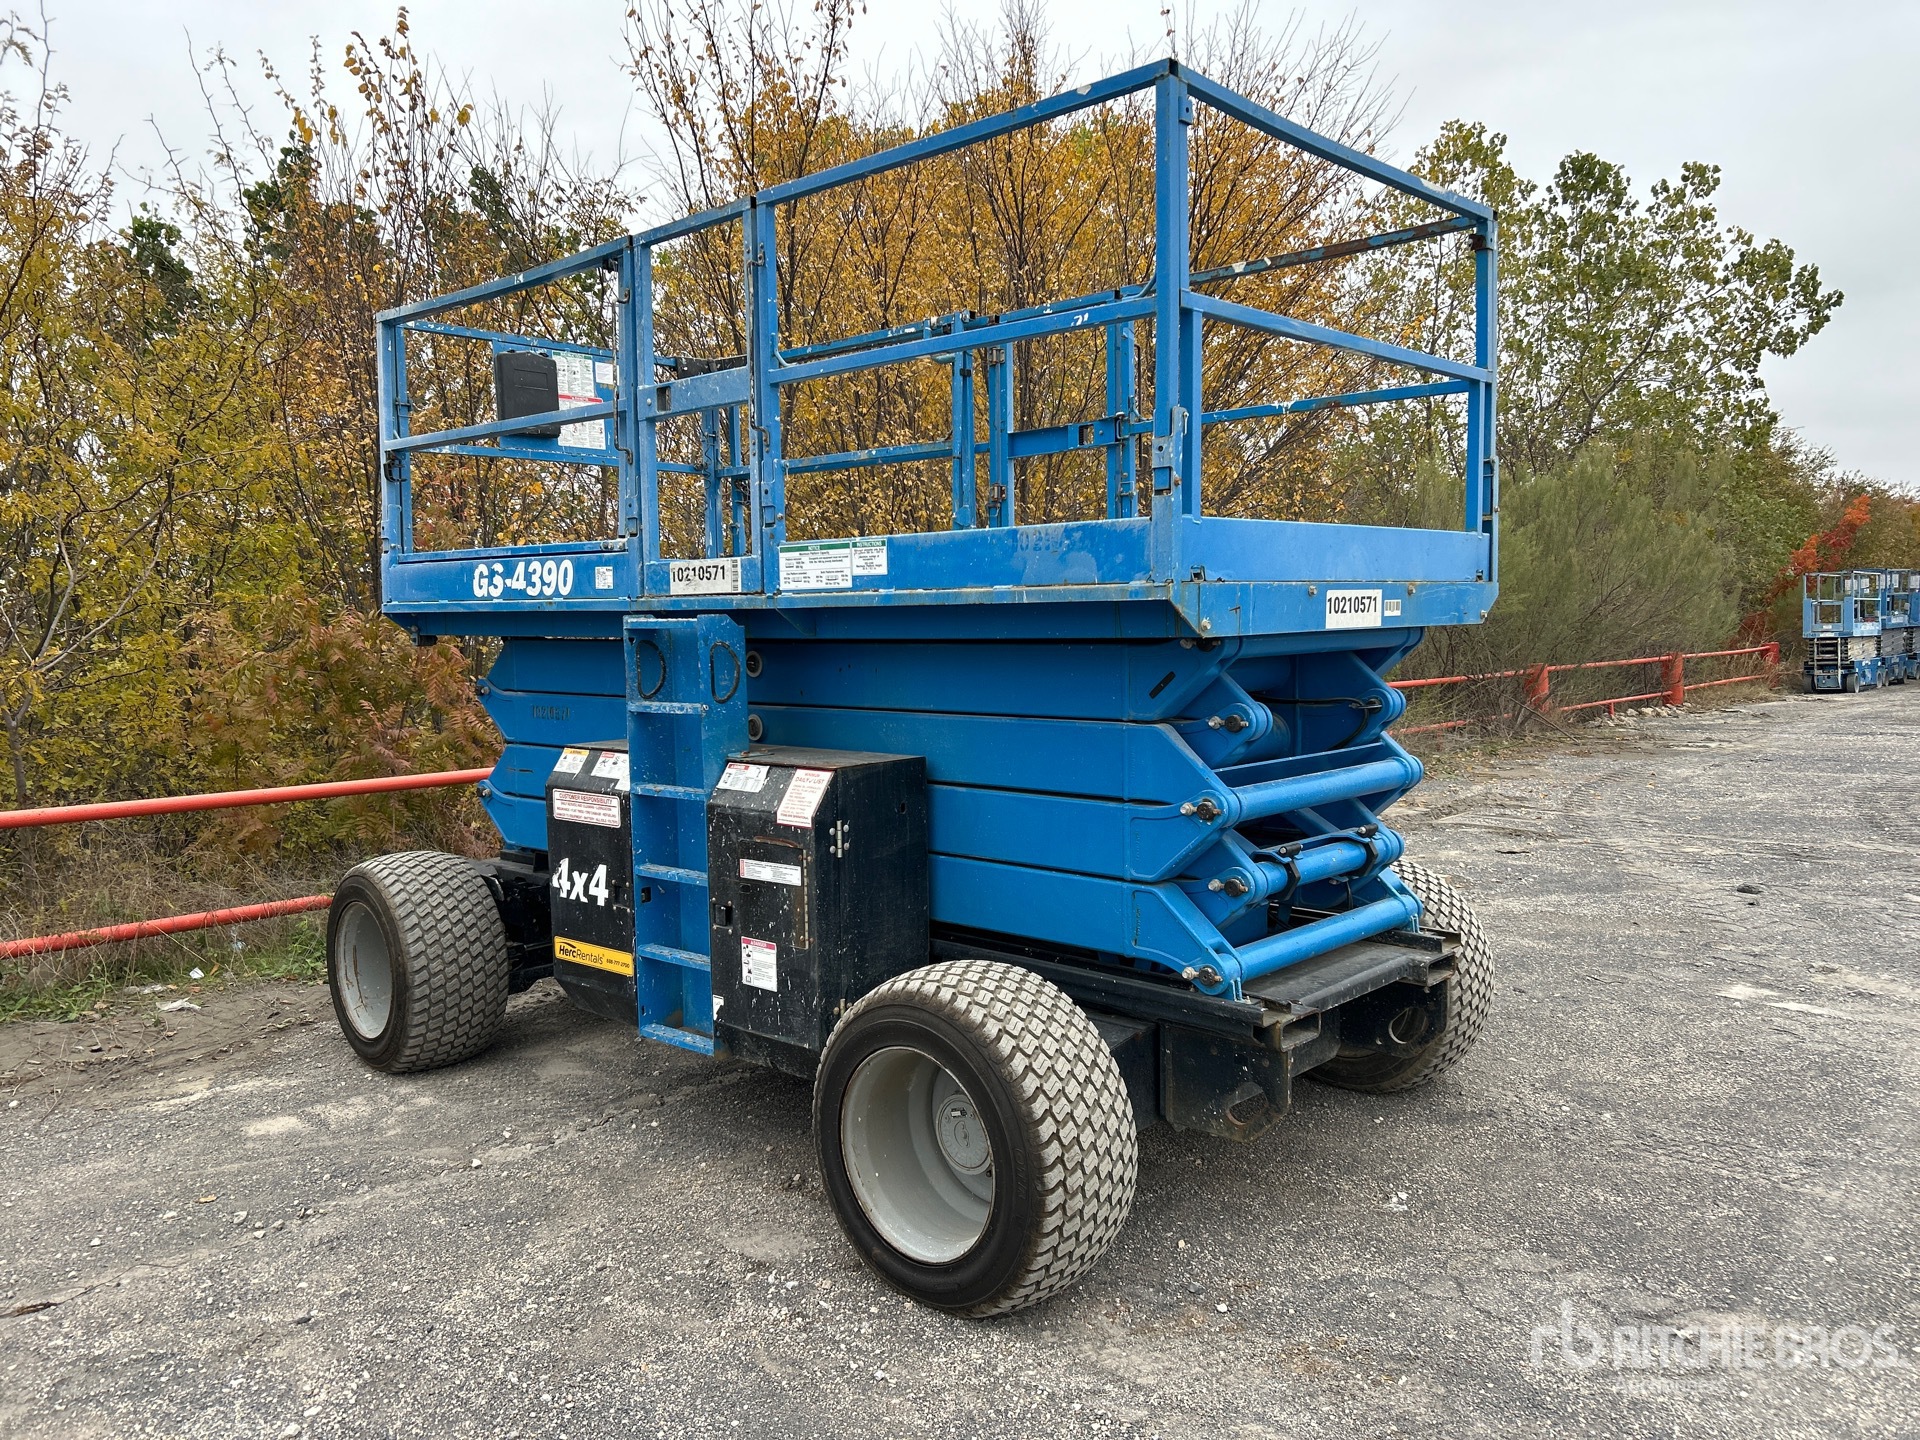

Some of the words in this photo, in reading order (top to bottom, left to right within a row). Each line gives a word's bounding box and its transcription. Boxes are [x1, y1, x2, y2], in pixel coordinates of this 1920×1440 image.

[671, 565, 725, 582] 10210571
[1328, 596, 1377, 614] 10210571
[552, 858, 609, 906] 4x4
